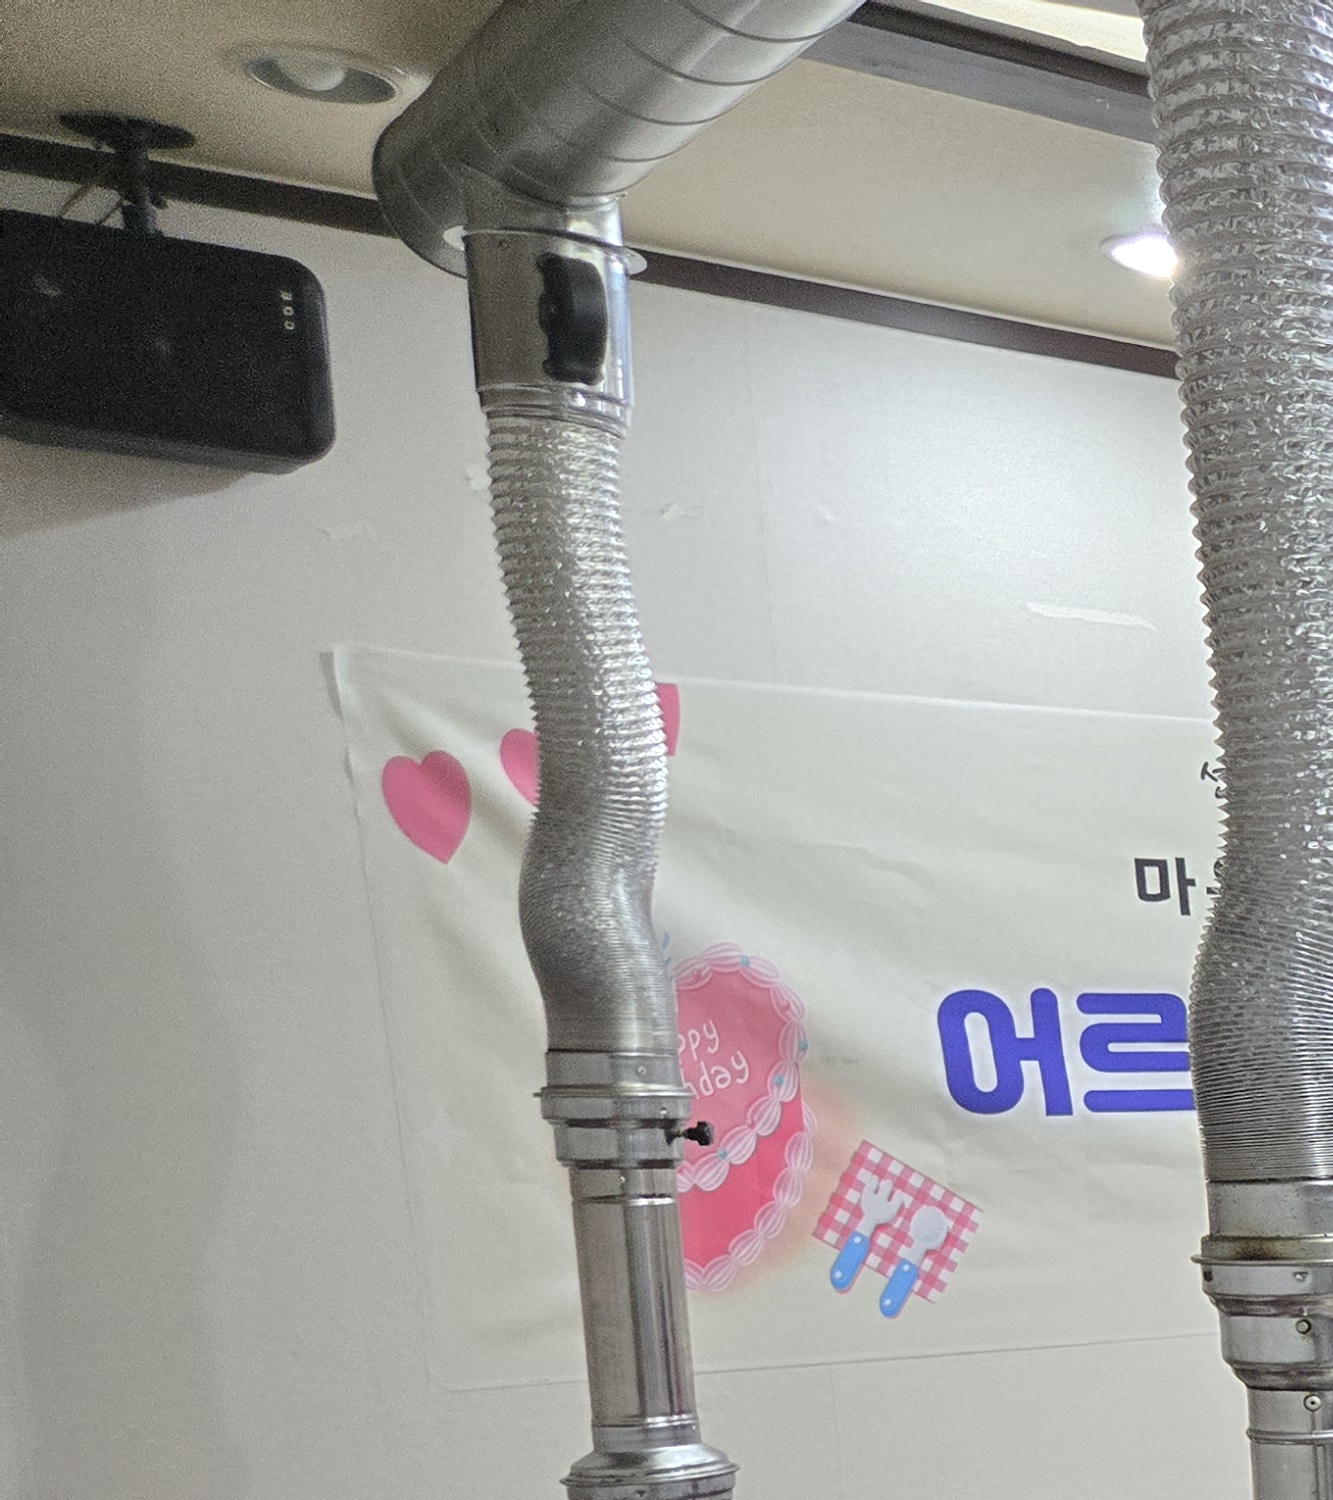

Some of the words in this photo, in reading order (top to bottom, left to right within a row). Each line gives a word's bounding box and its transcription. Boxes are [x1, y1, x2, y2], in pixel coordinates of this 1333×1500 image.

[1134, 857, 1224, 917] 마
[678, 1018, 720, 1061] ppy
[936, 986, 1198, 1117] 어르
